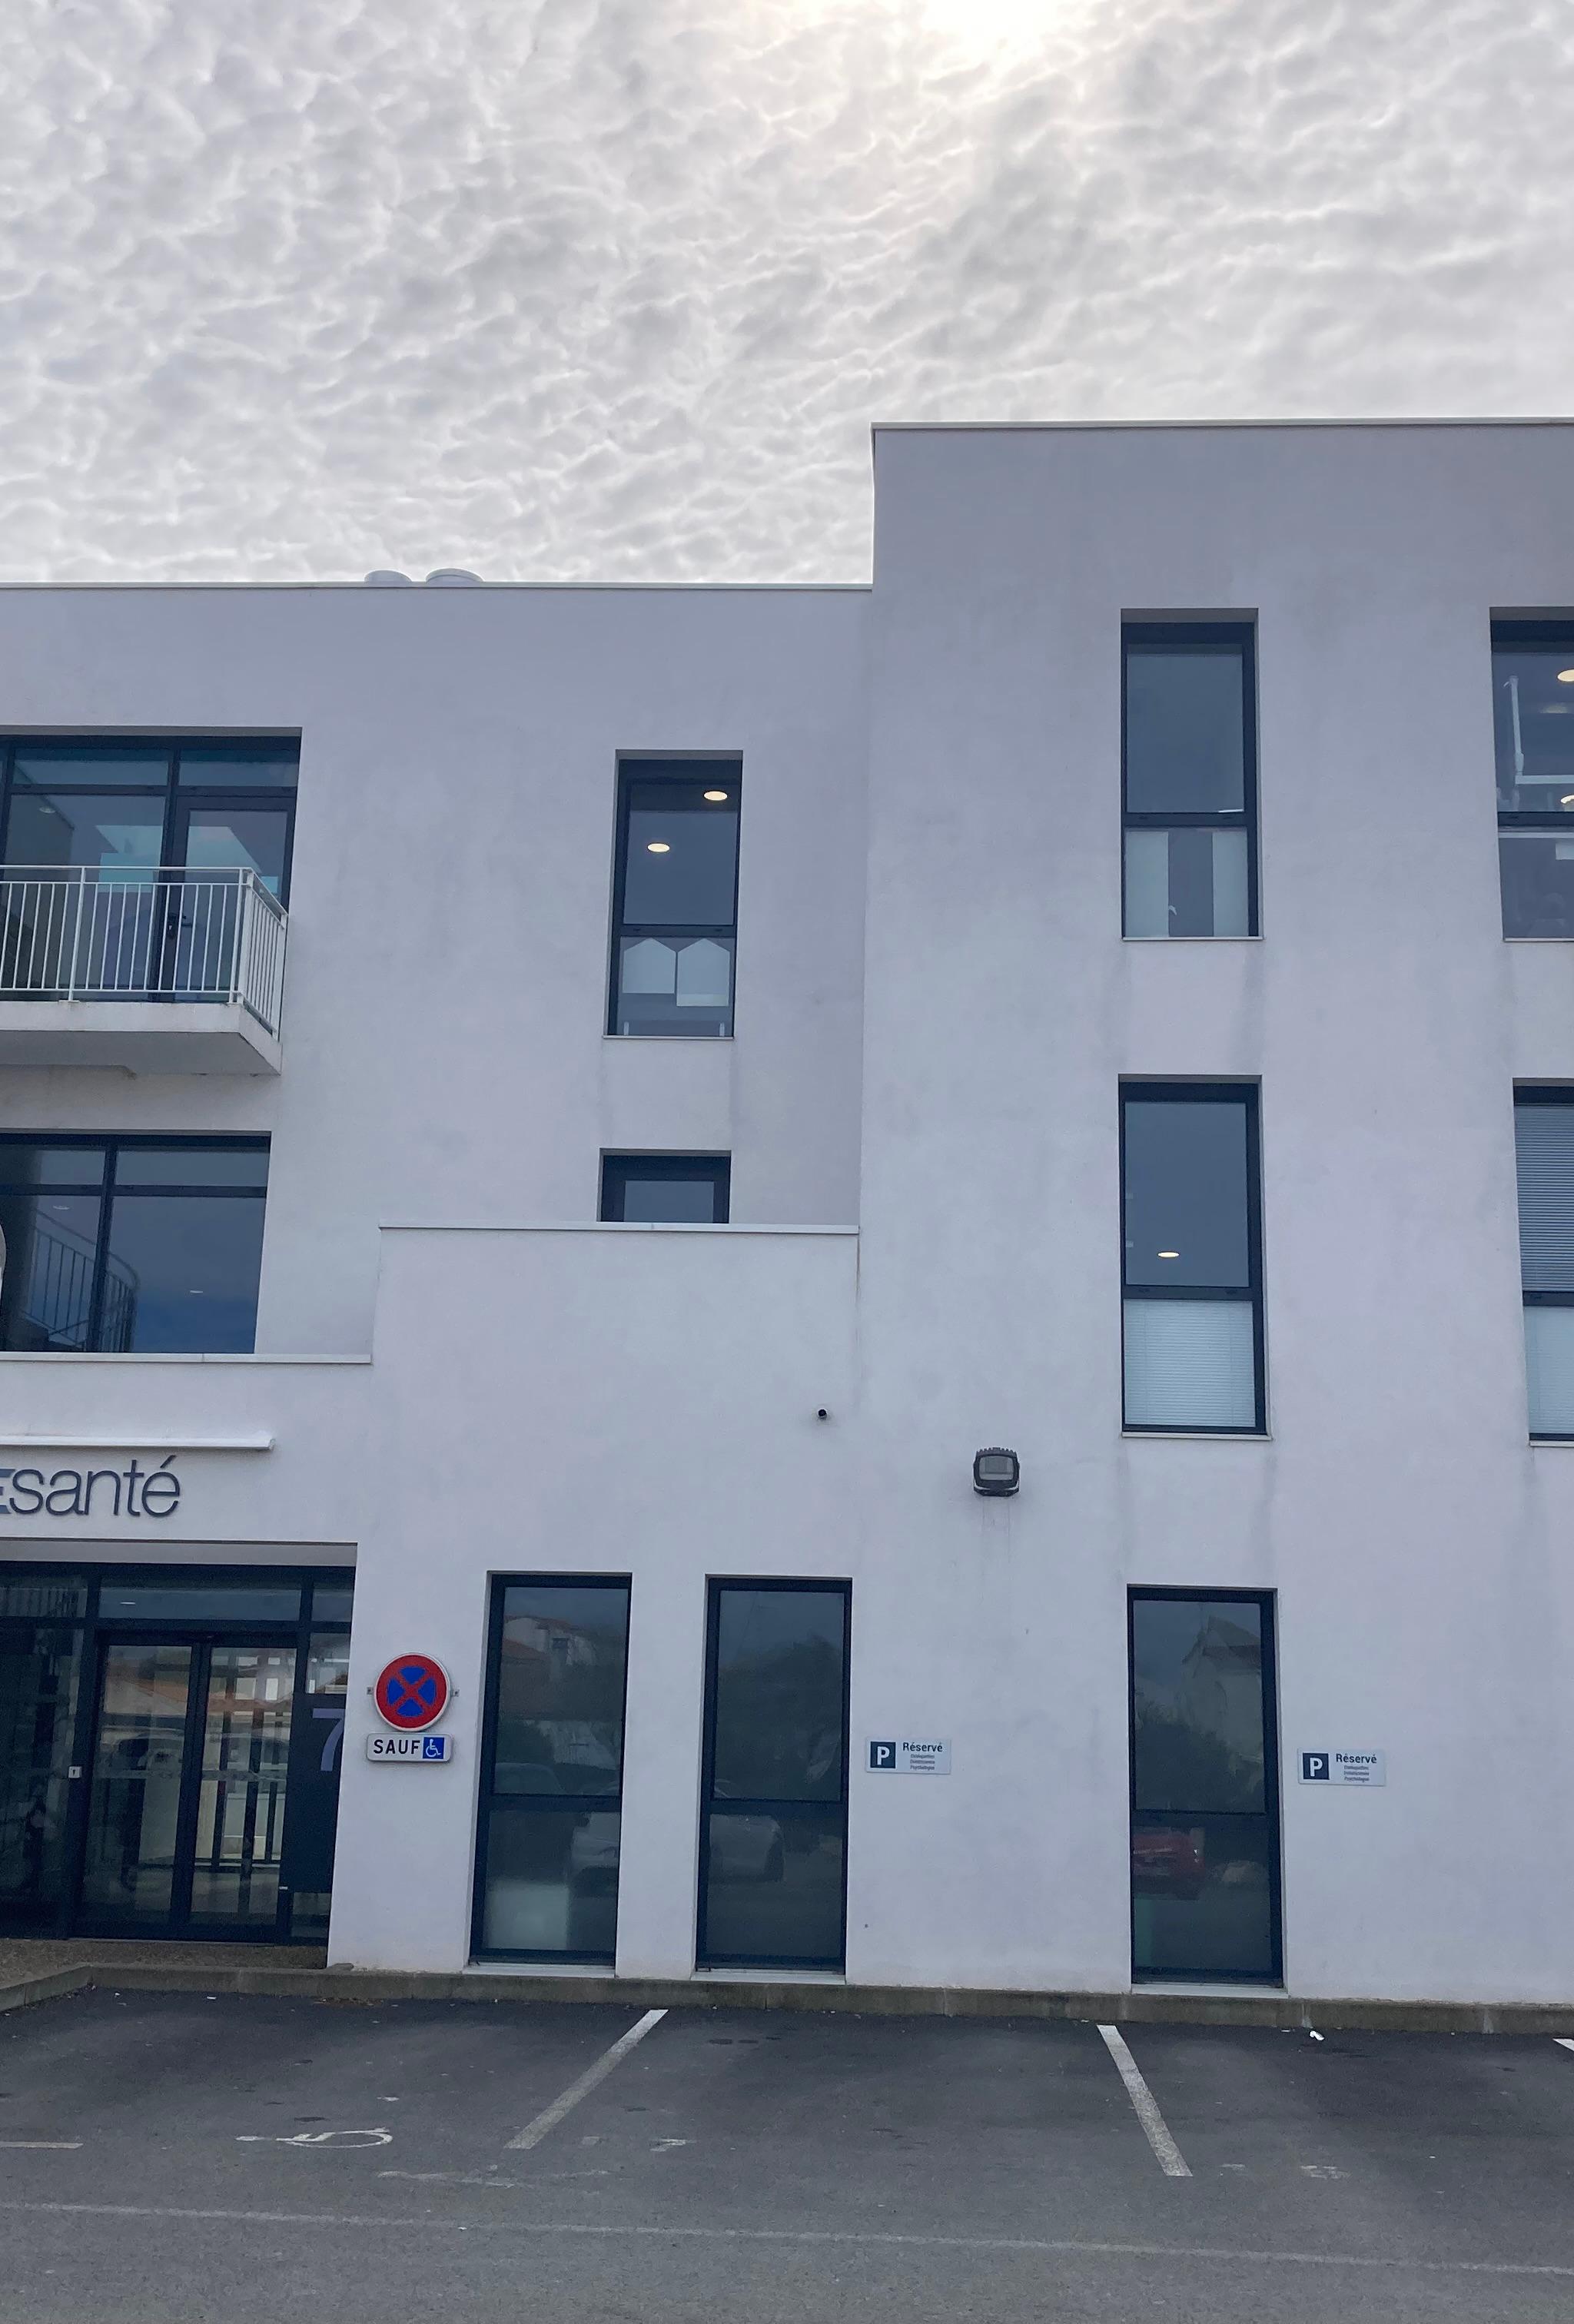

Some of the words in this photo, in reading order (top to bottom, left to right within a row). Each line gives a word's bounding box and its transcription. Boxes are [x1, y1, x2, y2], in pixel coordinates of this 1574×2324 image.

[373, 1738, 420, 1755] SAUF
[902, 1741, 943, 1752] Réservé
[877, 1746, 890, 1765] P
[1336, 1753, 1377, 1764] Réservé
[1310, 1757, 1323, 1777] P
